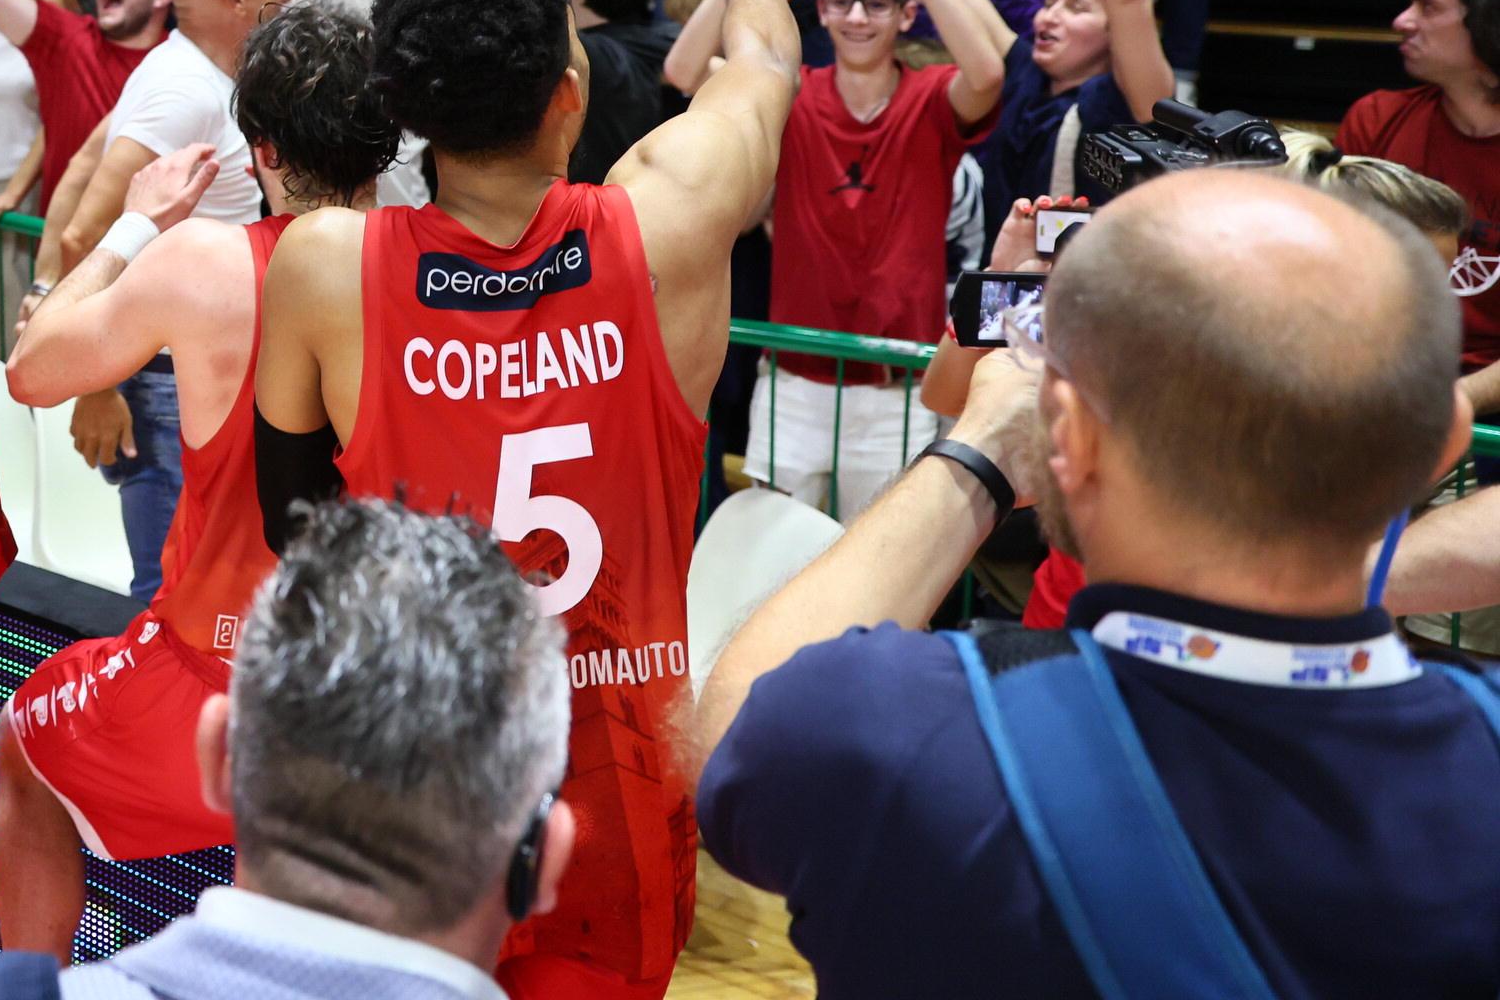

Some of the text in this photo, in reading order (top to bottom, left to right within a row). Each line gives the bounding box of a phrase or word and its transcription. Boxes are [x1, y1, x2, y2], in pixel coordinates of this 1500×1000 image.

[403, 320, 624, 401] COPELAND
[491, 422, 603, 618] 5
[571, 640, 686, 689] OMAUTO
